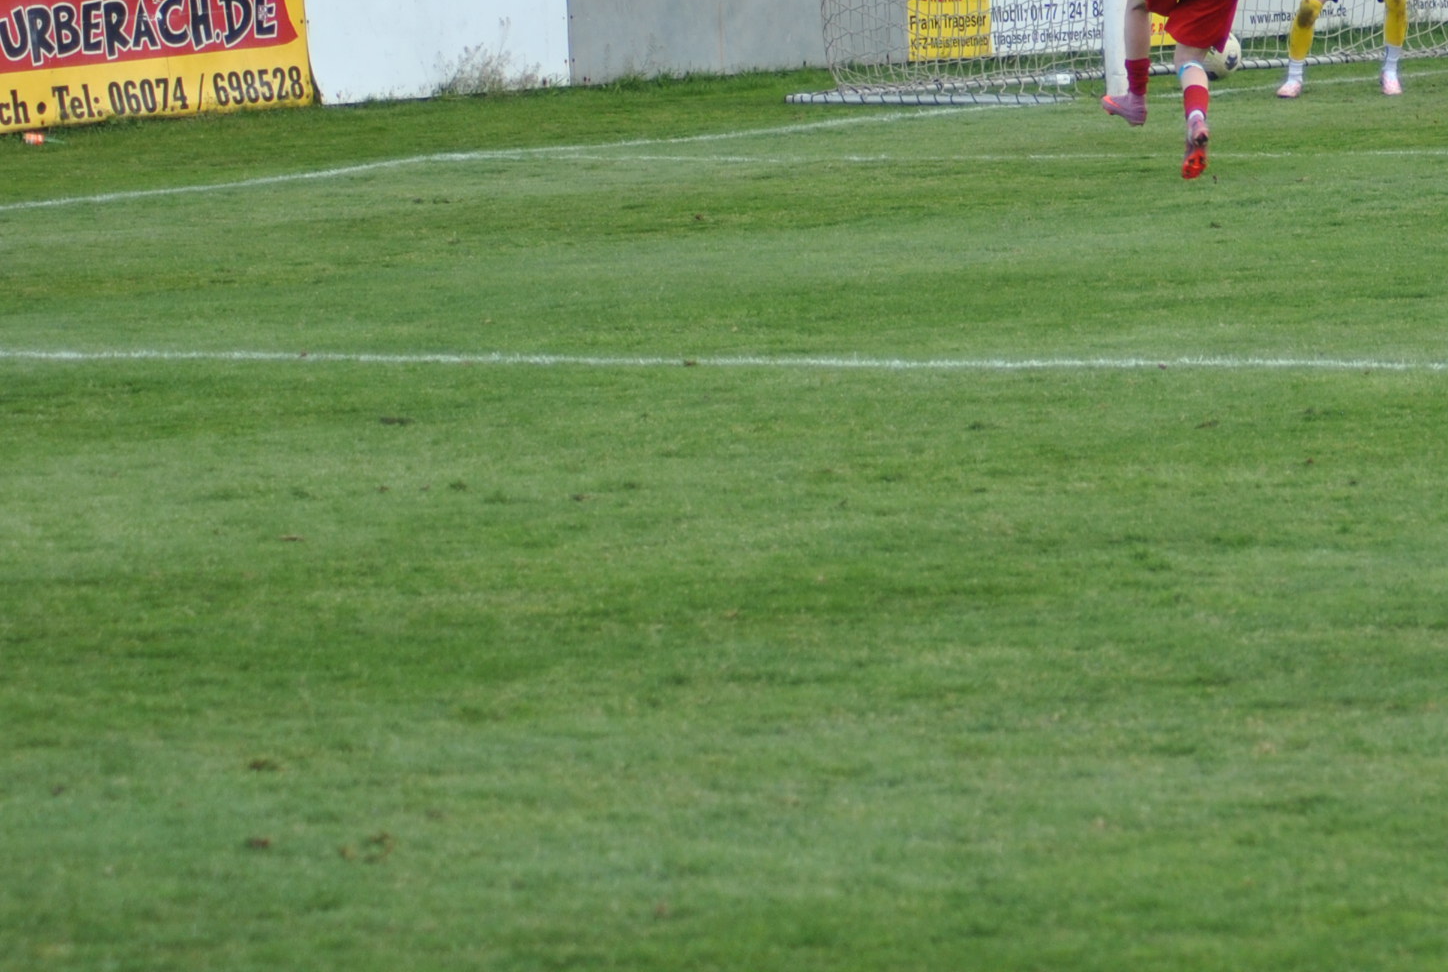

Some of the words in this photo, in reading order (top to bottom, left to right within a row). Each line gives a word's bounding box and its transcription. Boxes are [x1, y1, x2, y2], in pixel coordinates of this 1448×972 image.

[909, 13, 941, 31] Frank
[943, 13, 987, 32] Trageser
[992, 4, 1028, 23] Mobil:
[1030, 3, 1058, 21] 0177
[993, 28, 1103, 48] trageser@diekfzwerksta
[51, 84, 103, 121] Tel:
[108, 76, 189, 116] 06074
[212, 65, 304, 107] 698528
